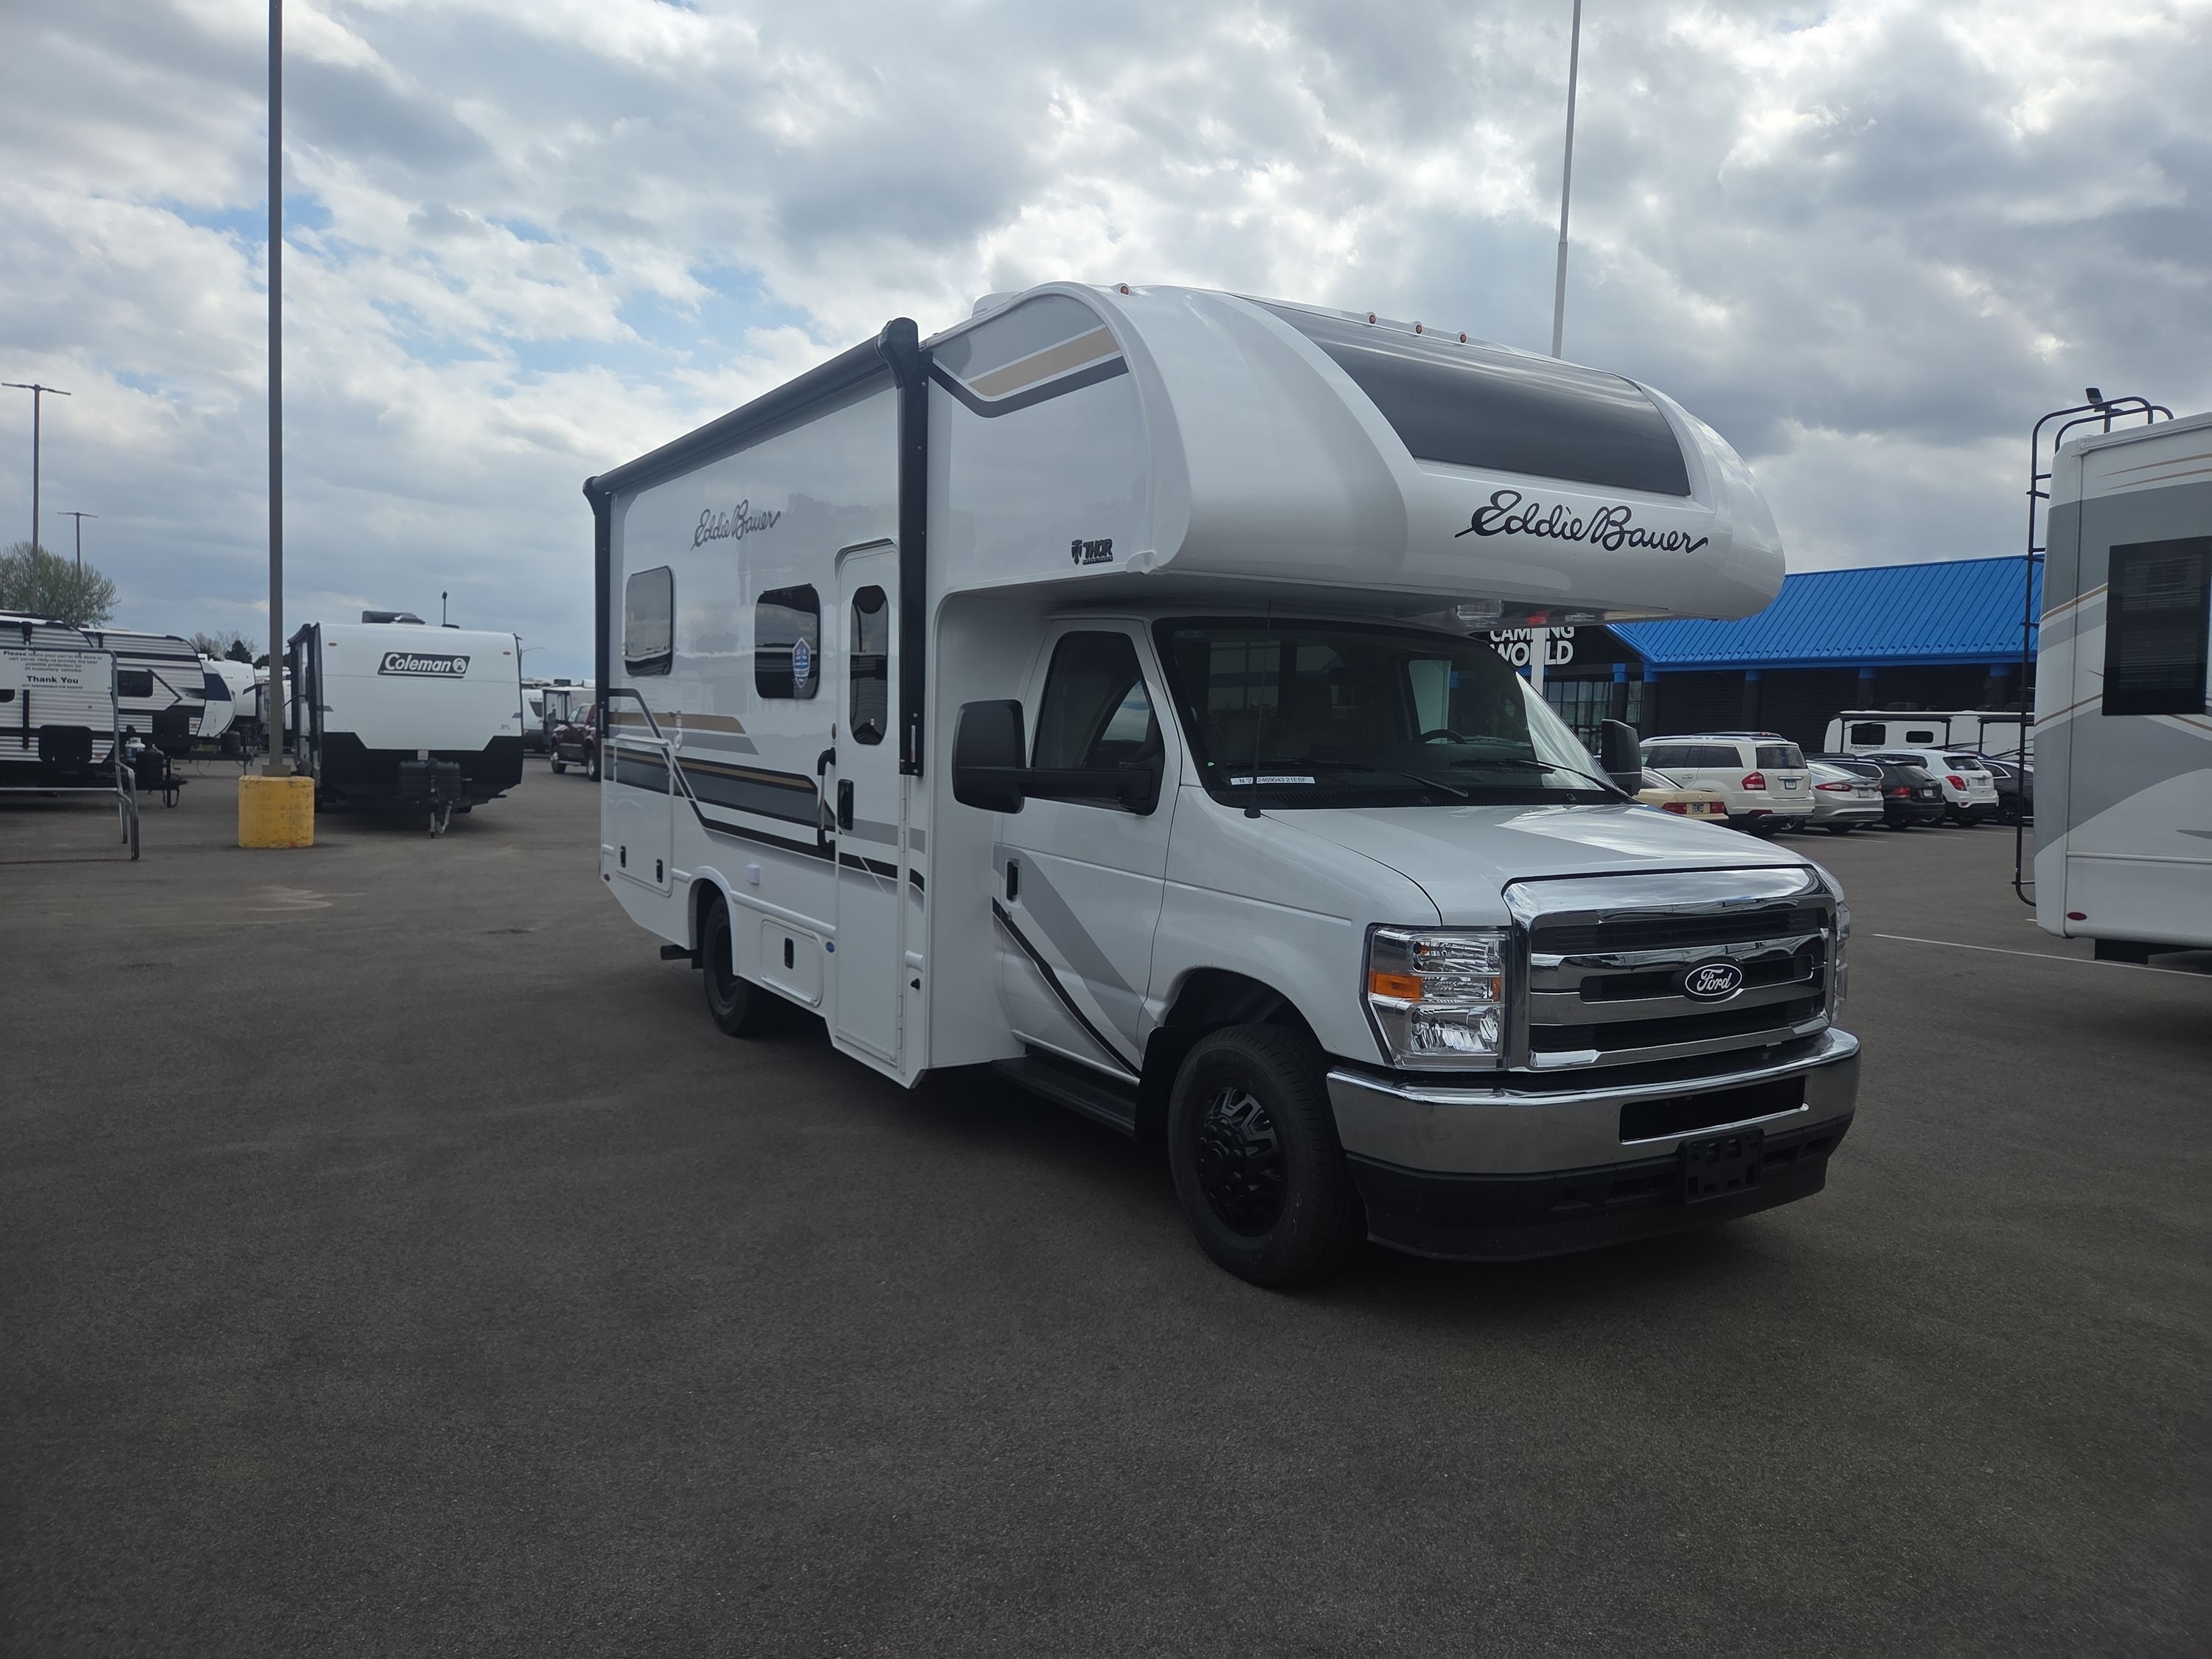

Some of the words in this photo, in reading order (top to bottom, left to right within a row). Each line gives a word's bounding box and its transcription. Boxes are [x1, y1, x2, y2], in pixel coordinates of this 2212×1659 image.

[690, 508, 731, 551] Eddie
[731, 498, 782, 540] Bauer
[1455, 490, 1586, 542] Eddie
[1590, 505, 1708, 554] Bauer
[1083, 538, 1113, 558] THOR
[385, 653, 451, 672] Coleman
[1489, 640, 1574, 667] WOLD
[1697, 969, 1732, 992] Ford
